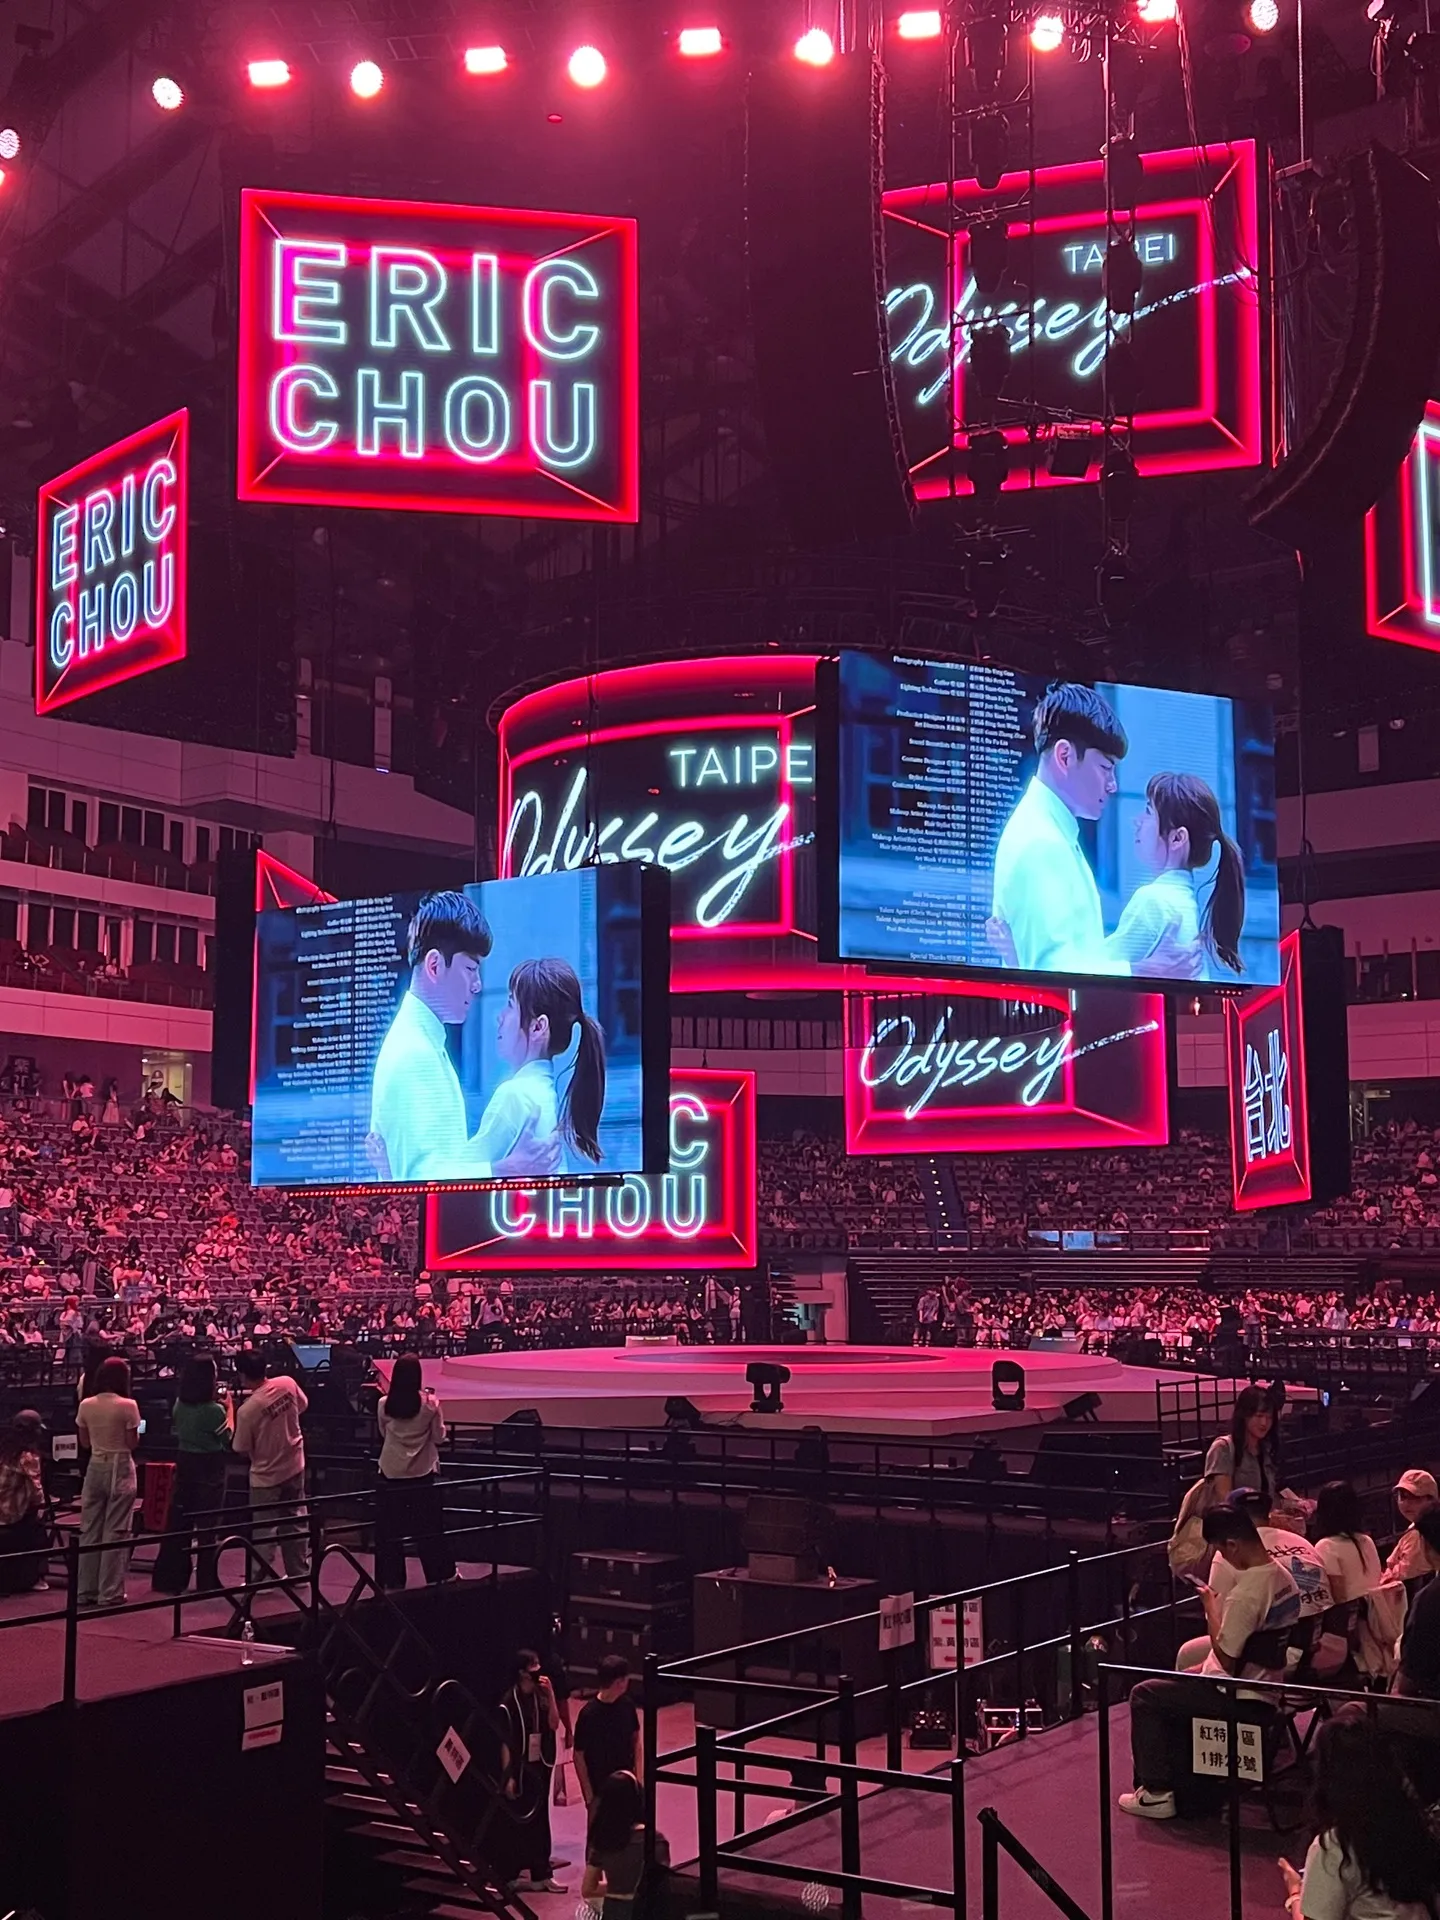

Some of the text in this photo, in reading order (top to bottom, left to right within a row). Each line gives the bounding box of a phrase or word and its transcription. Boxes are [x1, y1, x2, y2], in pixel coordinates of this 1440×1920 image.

[272, 237, 600, 360] ERIC
[1064, 232, 1177, 274] TAEI
[269, 364, 596, 468] CHOU
[51, 457, 177, 591] ERIC
[49, 553, 174, 669] CHOU
[669, 744, 813, 788] TAIPE
[860, 1006, 1073, 1119] Odyssey
[491, 1174, 706, 1238] CHOU
[1200, 1725, 1255, 1746] 紅特區
